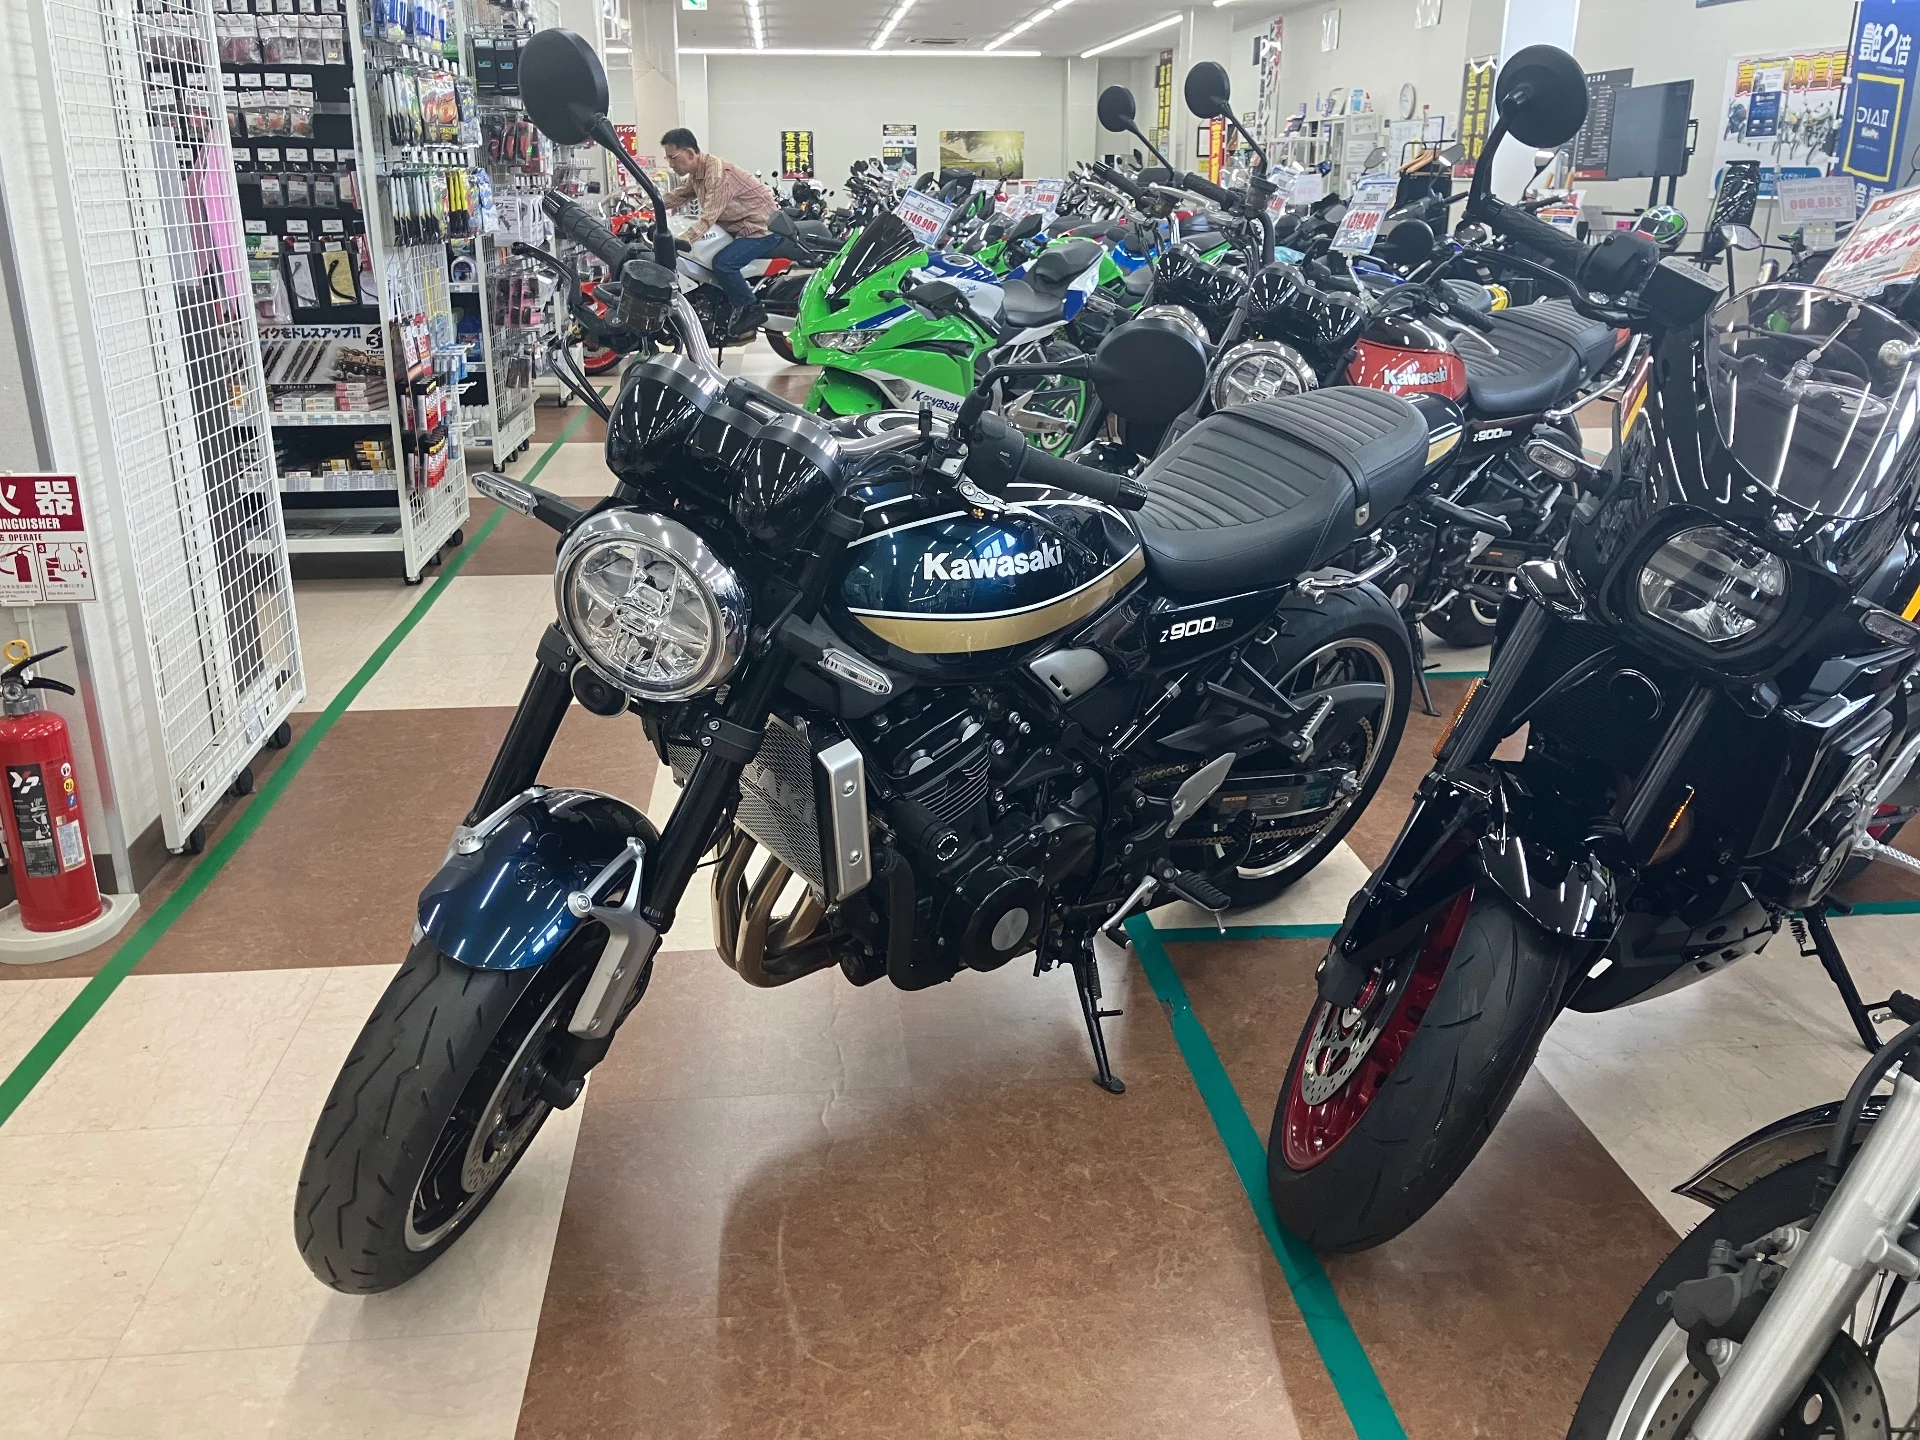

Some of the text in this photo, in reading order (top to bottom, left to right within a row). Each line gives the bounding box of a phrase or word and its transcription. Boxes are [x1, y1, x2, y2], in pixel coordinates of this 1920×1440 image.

[1737, 54, 1848, 94] 高取宣言
[903, 209, 938, 234] 1,149,900
[259, 326, 361, 339] イクをドレスアップ!!
[1383, 366, 1448, 386] Kawasaki
[911, 389, 961, 414] Kawasak
[8, 533, 43, 542] OPERATE
[923, 538, 1063, 581] Kawasaki
